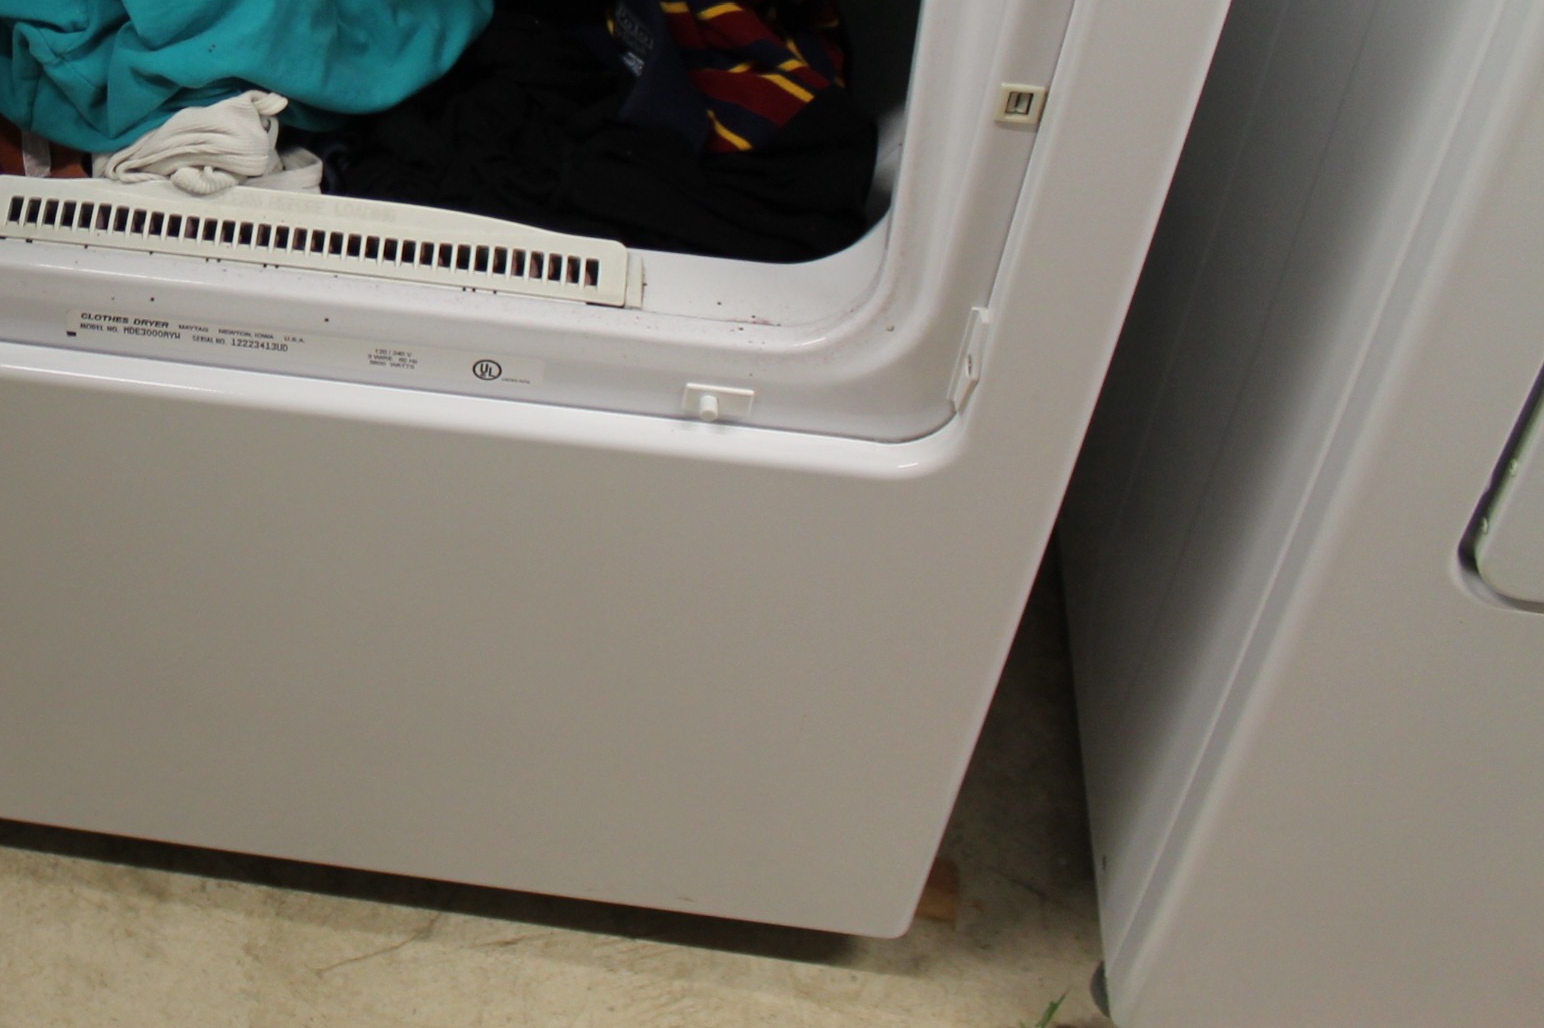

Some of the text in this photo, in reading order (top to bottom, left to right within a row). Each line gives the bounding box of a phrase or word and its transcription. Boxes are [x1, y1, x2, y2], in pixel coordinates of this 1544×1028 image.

[79, 322, 103, 331] MODEL
[192, 335, 214, 343] SERIAL
[81, 312, 129, 324] CLOTHES
[133, 318, 169, 329] DRYER
[178, 324, 208, 333] MAYTAG
